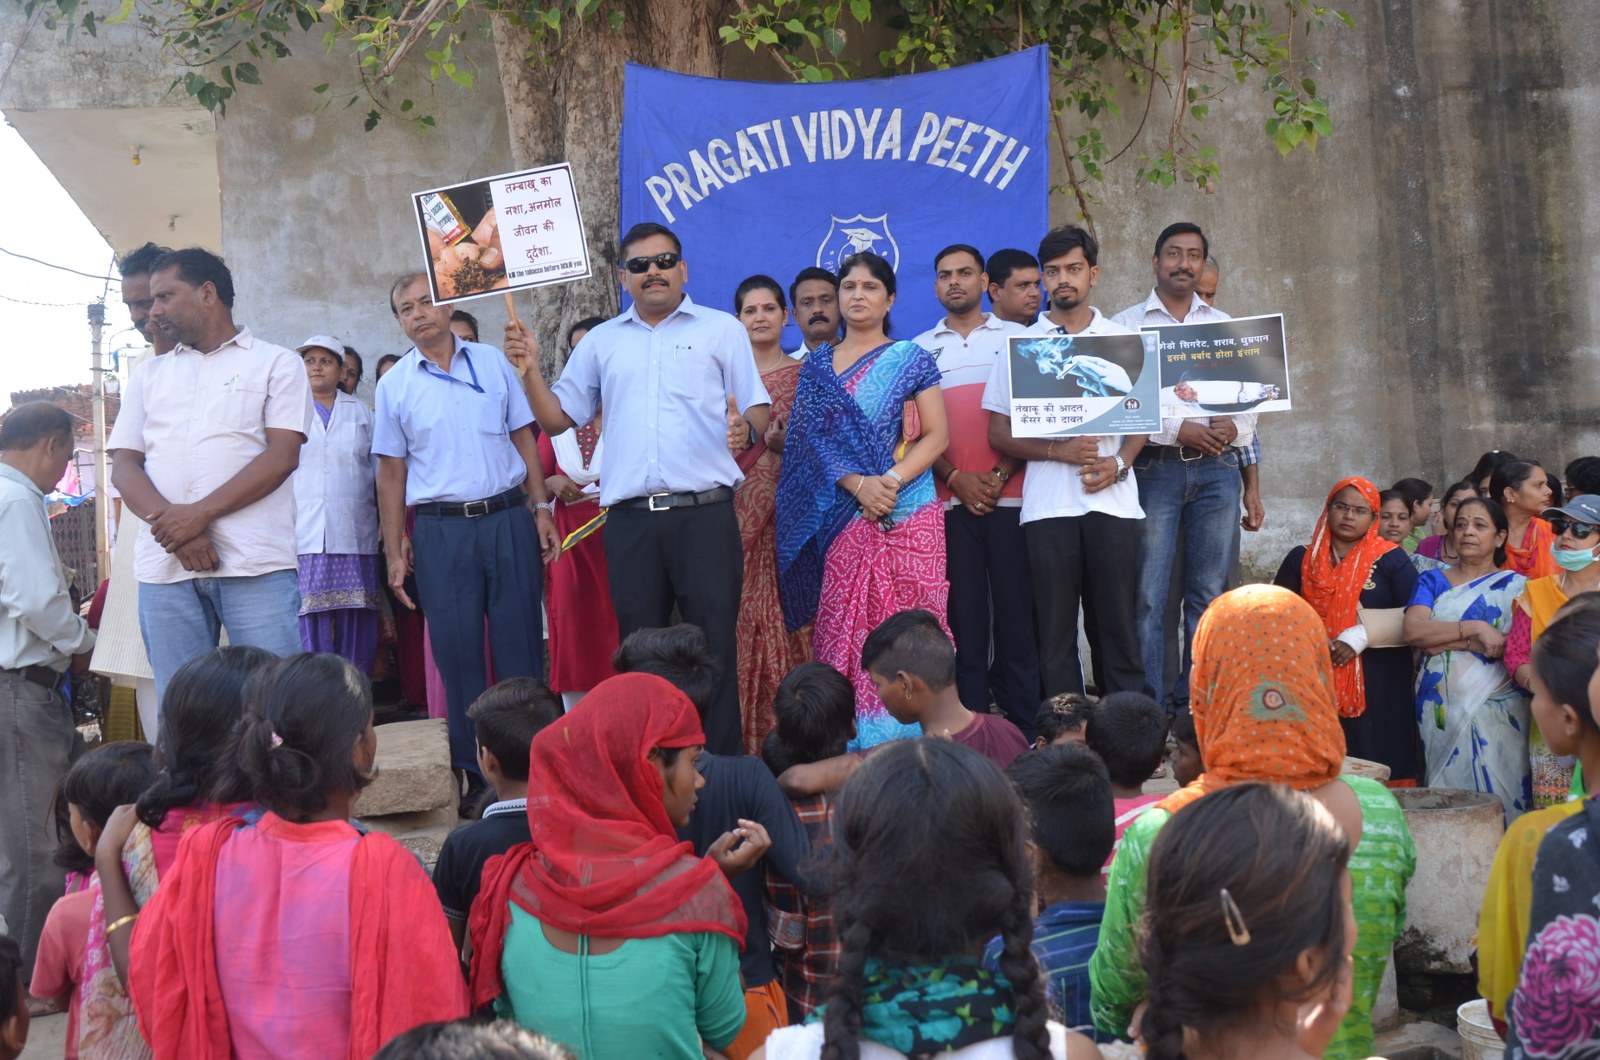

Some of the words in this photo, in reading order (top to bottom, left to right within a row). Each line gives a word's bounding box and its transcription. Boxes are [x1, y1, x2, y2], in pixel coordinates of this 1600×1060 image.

[645, 119, 792, 225] PRAGATI
[790, 107, 902, 162] VIDYA
[906, 111, 1031, 192] PEETH
[505, 179, 540, 194] तम्बाखू
[540, 176, 552, 187] का
[513, 224, 538, 238] जीवन
[543, 219, 555, 232] की
[1166, 351, 1187, 363] इससे
[1215, 348, 1234, 360] होता
[1237, 347, 1260, 359] इंसान
[1043, 402, 1054, 413] की
[1045, 413, 1057, 424] को
